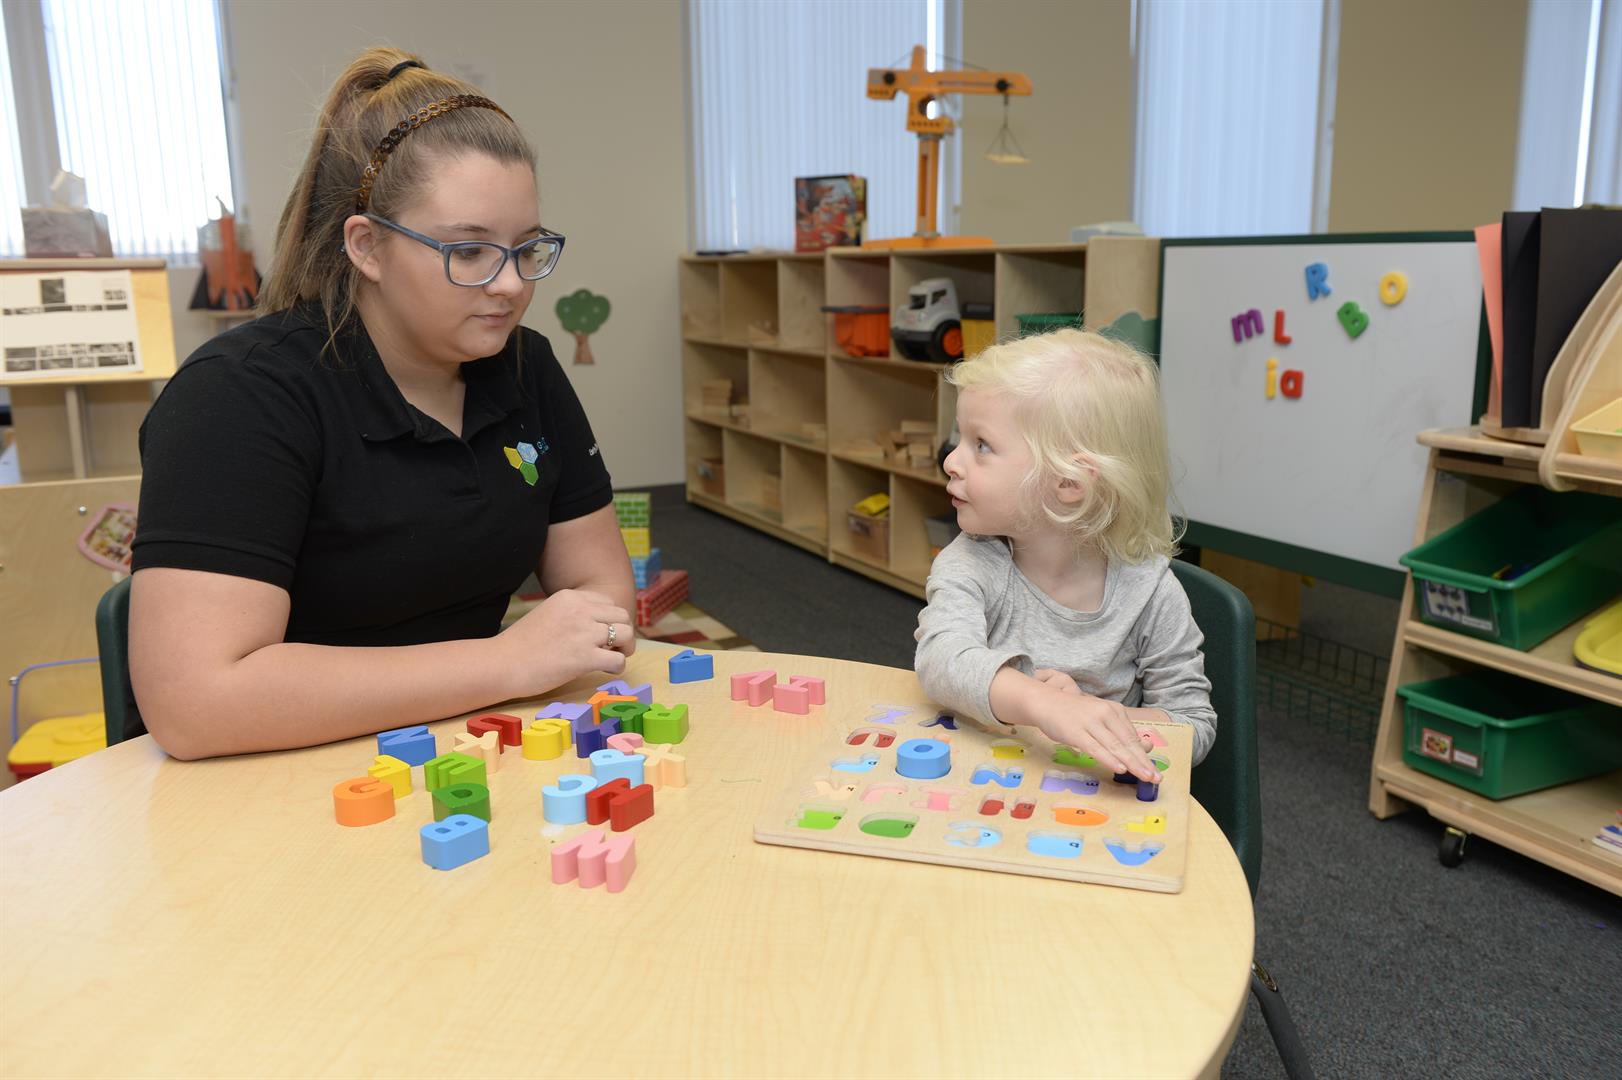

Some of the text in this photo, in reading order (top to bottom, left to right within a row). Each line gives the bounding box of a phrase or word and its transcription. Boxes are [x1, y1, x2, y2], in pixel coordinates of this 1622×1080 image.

[1305, 262, 1333, 301] R
[1274, 309, 1292, 346] L
[1337, 301, 1370, 340] B
[420, 814, 490, 871] B
